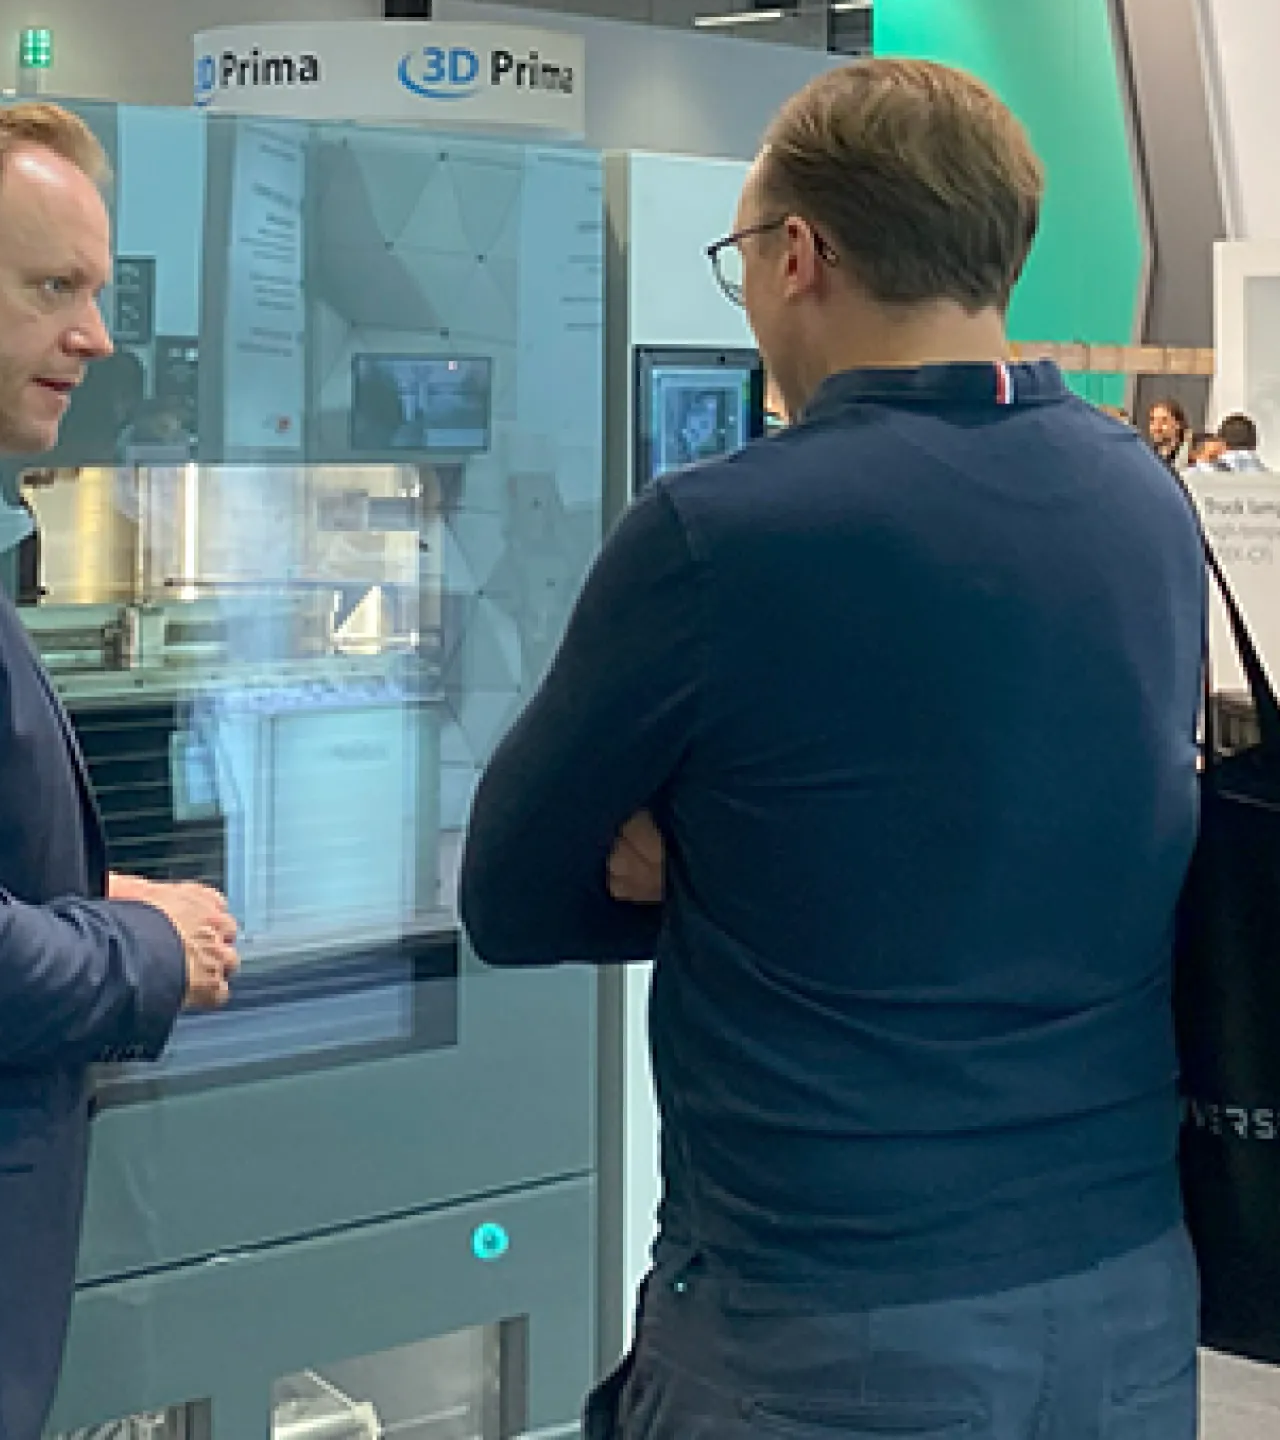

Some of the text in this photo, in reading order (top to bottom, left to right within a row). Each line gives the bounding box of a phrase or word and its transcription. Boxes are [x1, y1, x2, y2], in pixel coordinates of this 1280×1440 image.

[220, 46, 319, 87] Prima
[420, 45, 574, 95] 3D Prima
